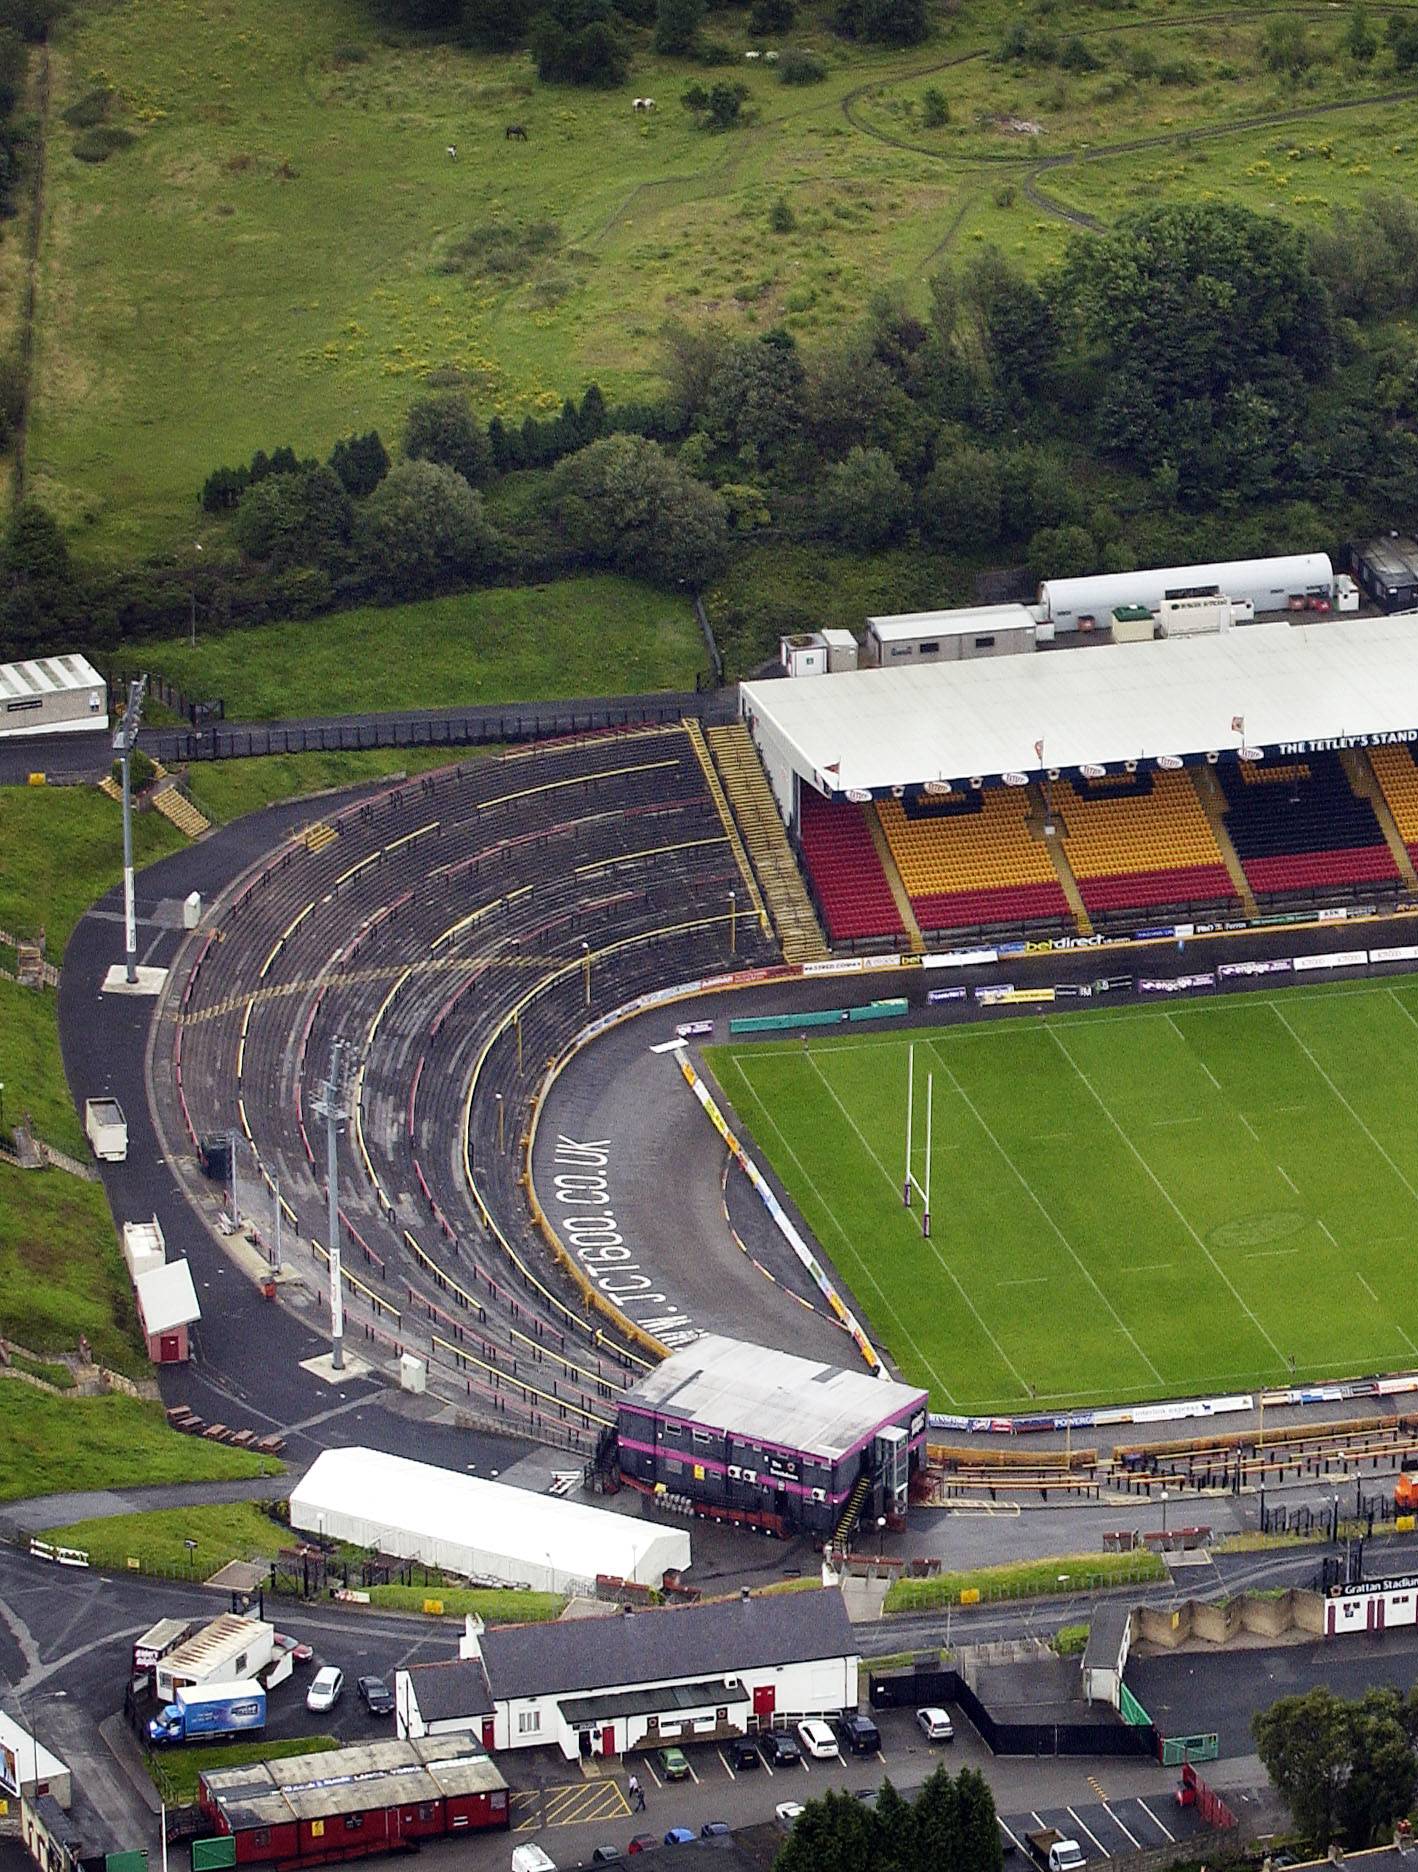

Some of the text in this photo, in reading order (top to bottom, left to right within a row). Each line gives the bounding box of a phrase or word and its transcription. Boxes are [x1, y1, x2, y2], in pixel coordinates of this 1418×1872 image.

[1279, 731, 1418, 755] THE TETLEY'S STAND
[1345, 1580, 1381, 1595] Grattan
